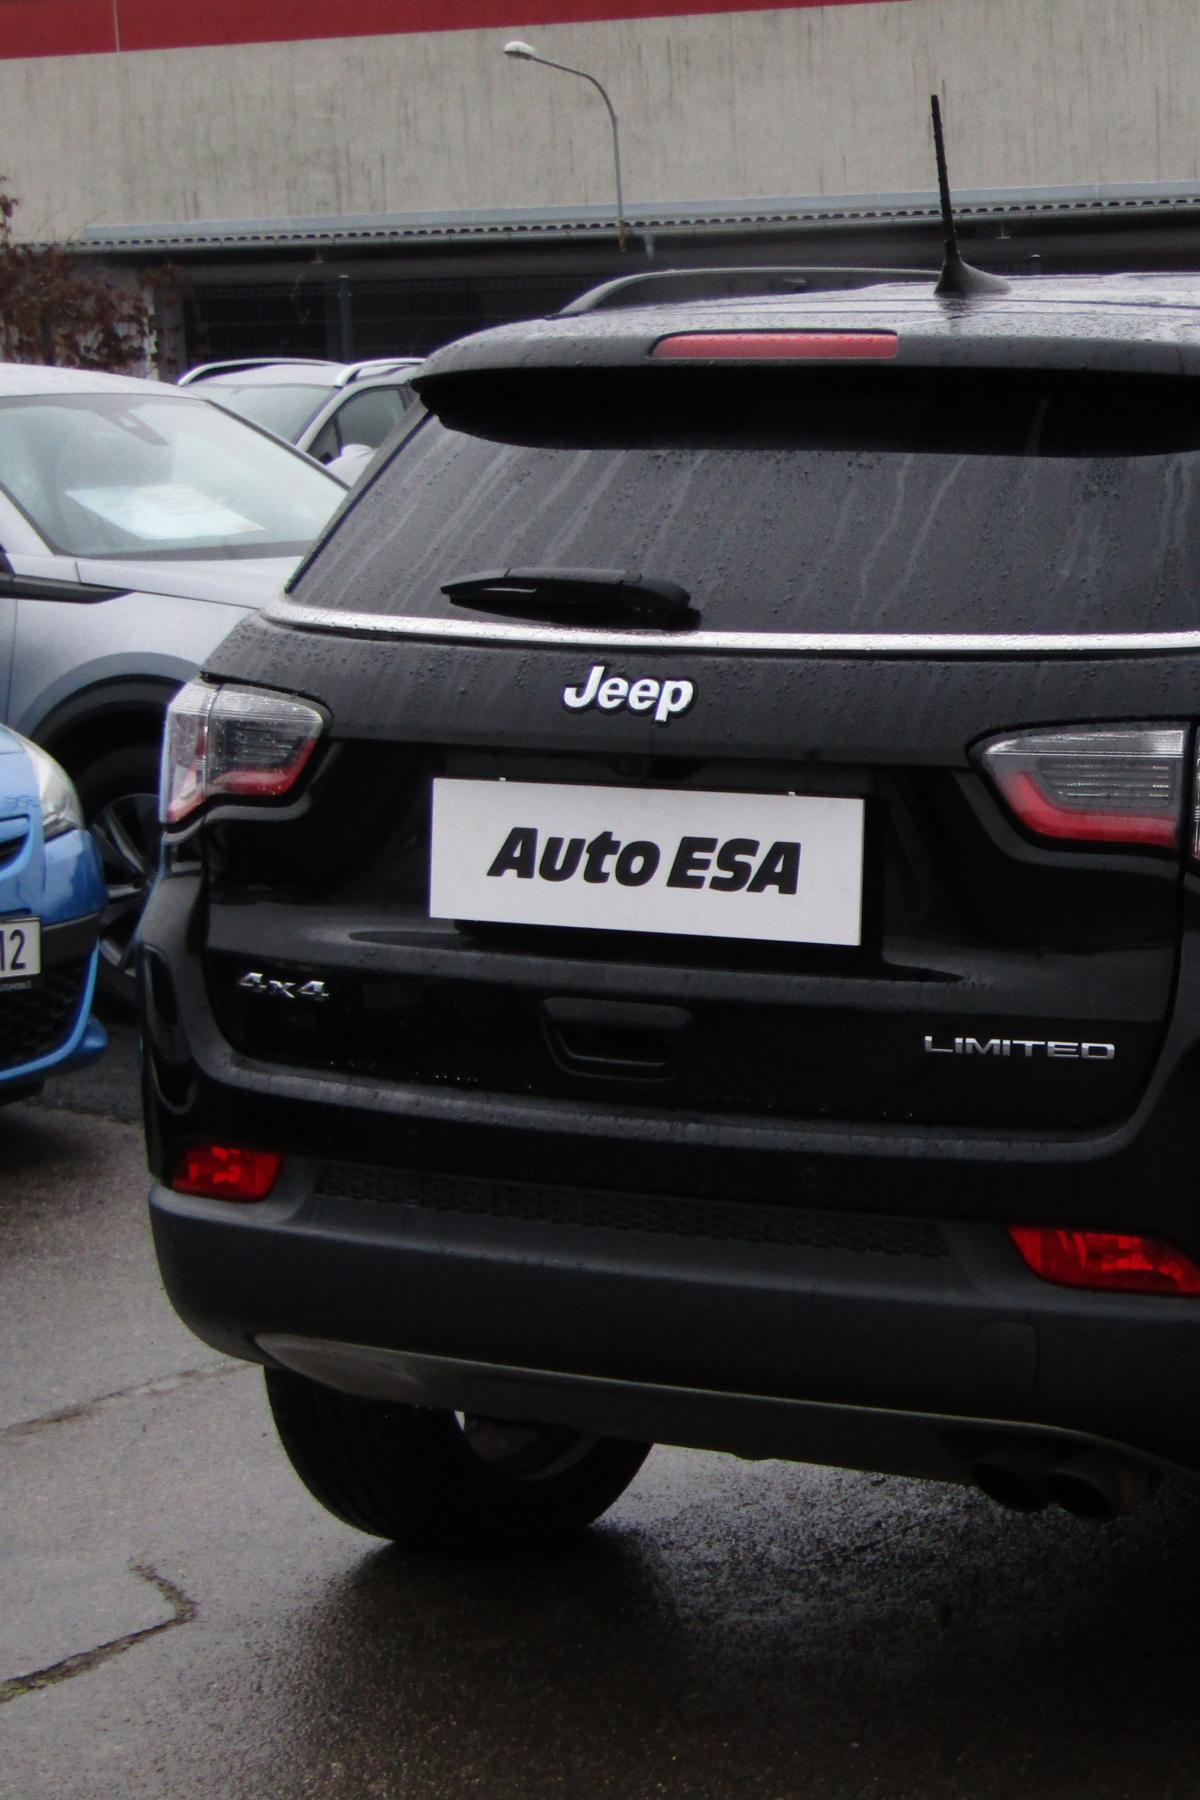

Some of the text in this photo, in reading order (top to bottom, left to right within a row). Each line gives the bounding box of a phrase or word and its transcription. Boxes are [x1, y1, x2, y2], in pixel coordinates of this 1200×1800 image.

[563, 665, 694, 722] Jeep
[486, 826, 802, 895] Auto ESA
[924, 1035, 1116, 1060] LIMITED
